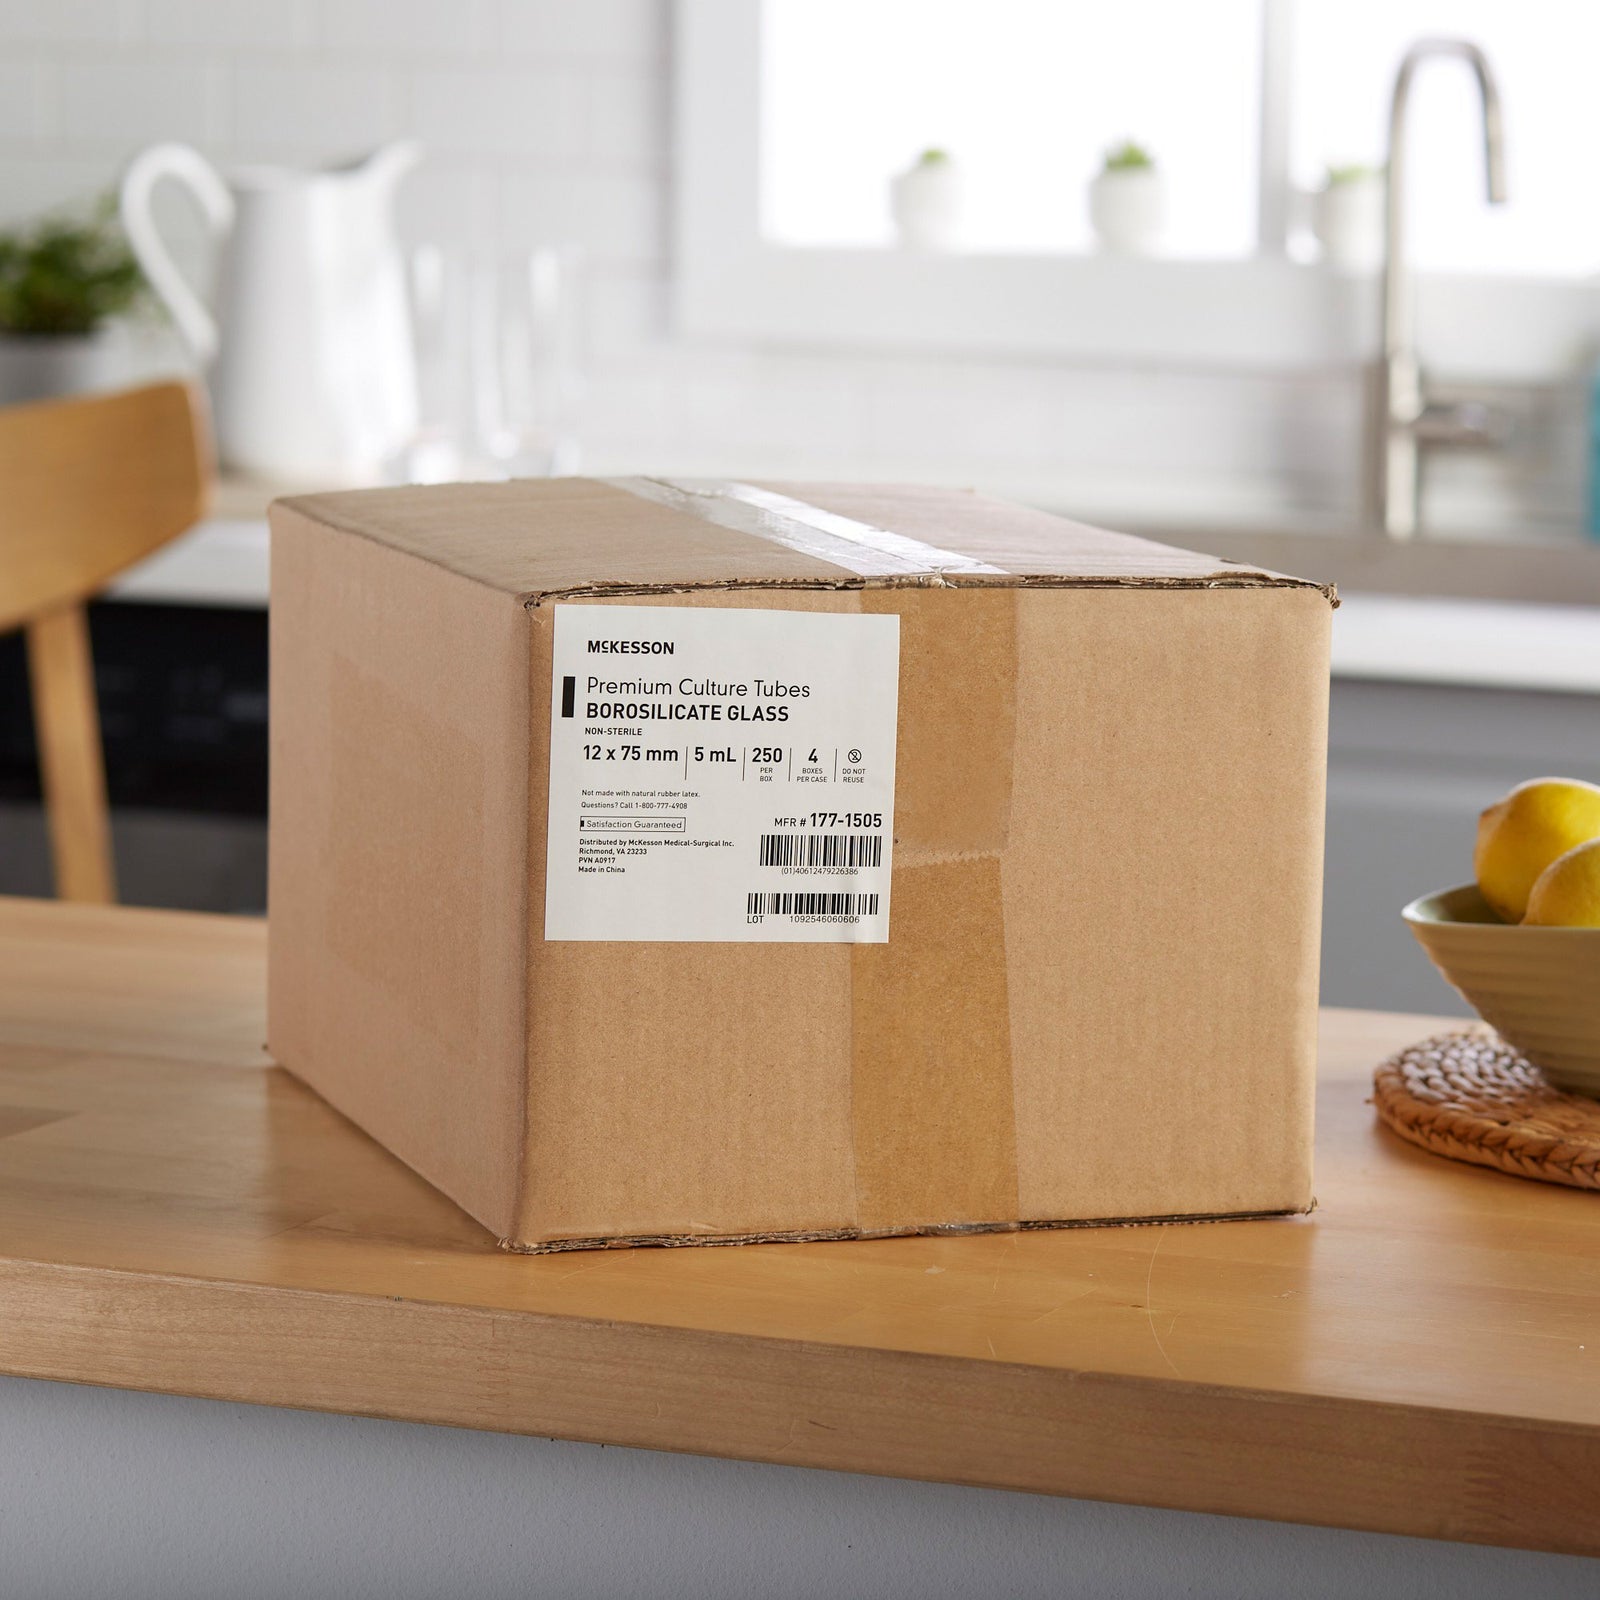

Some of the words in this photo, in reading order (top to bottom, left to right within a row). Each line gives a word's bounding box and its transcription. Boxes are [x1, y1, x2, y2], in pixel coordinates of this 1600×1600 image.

[587, 676, 672, 695] Premium
[678, 678, 748, 697] Culture
[754, 679, 811, 698] Tubes
[586, 703, 722, 720] BOROSILICATE
[727, 705, 789, 721] GLASS
[584, 727, 643, 736] NON-STERILE
[583, 745, 601, 760] 12
[606, 749, 616, 760] x
[621, 745, 641, 761] 75
[646, 749, 678, 762] mm
[694, 747, 704, 762] 5
[709, 747, 737, 763] mL
[752, 747, 782, 763] 250
[808, 748, 818, 763] 4
[635, 802, 688, 810] 1-800-777-4908
[586, 820, 632, 828] Satisfaction
[633, 820, 682, 829] Guaranteed
[774, 817, 797, 827] MFR
[799, 818, 807, 827] #
[810, 812, 882, 828] 177-1505
[619, 839, 627, 847] by
[747, 915, 764, 924] LOT
